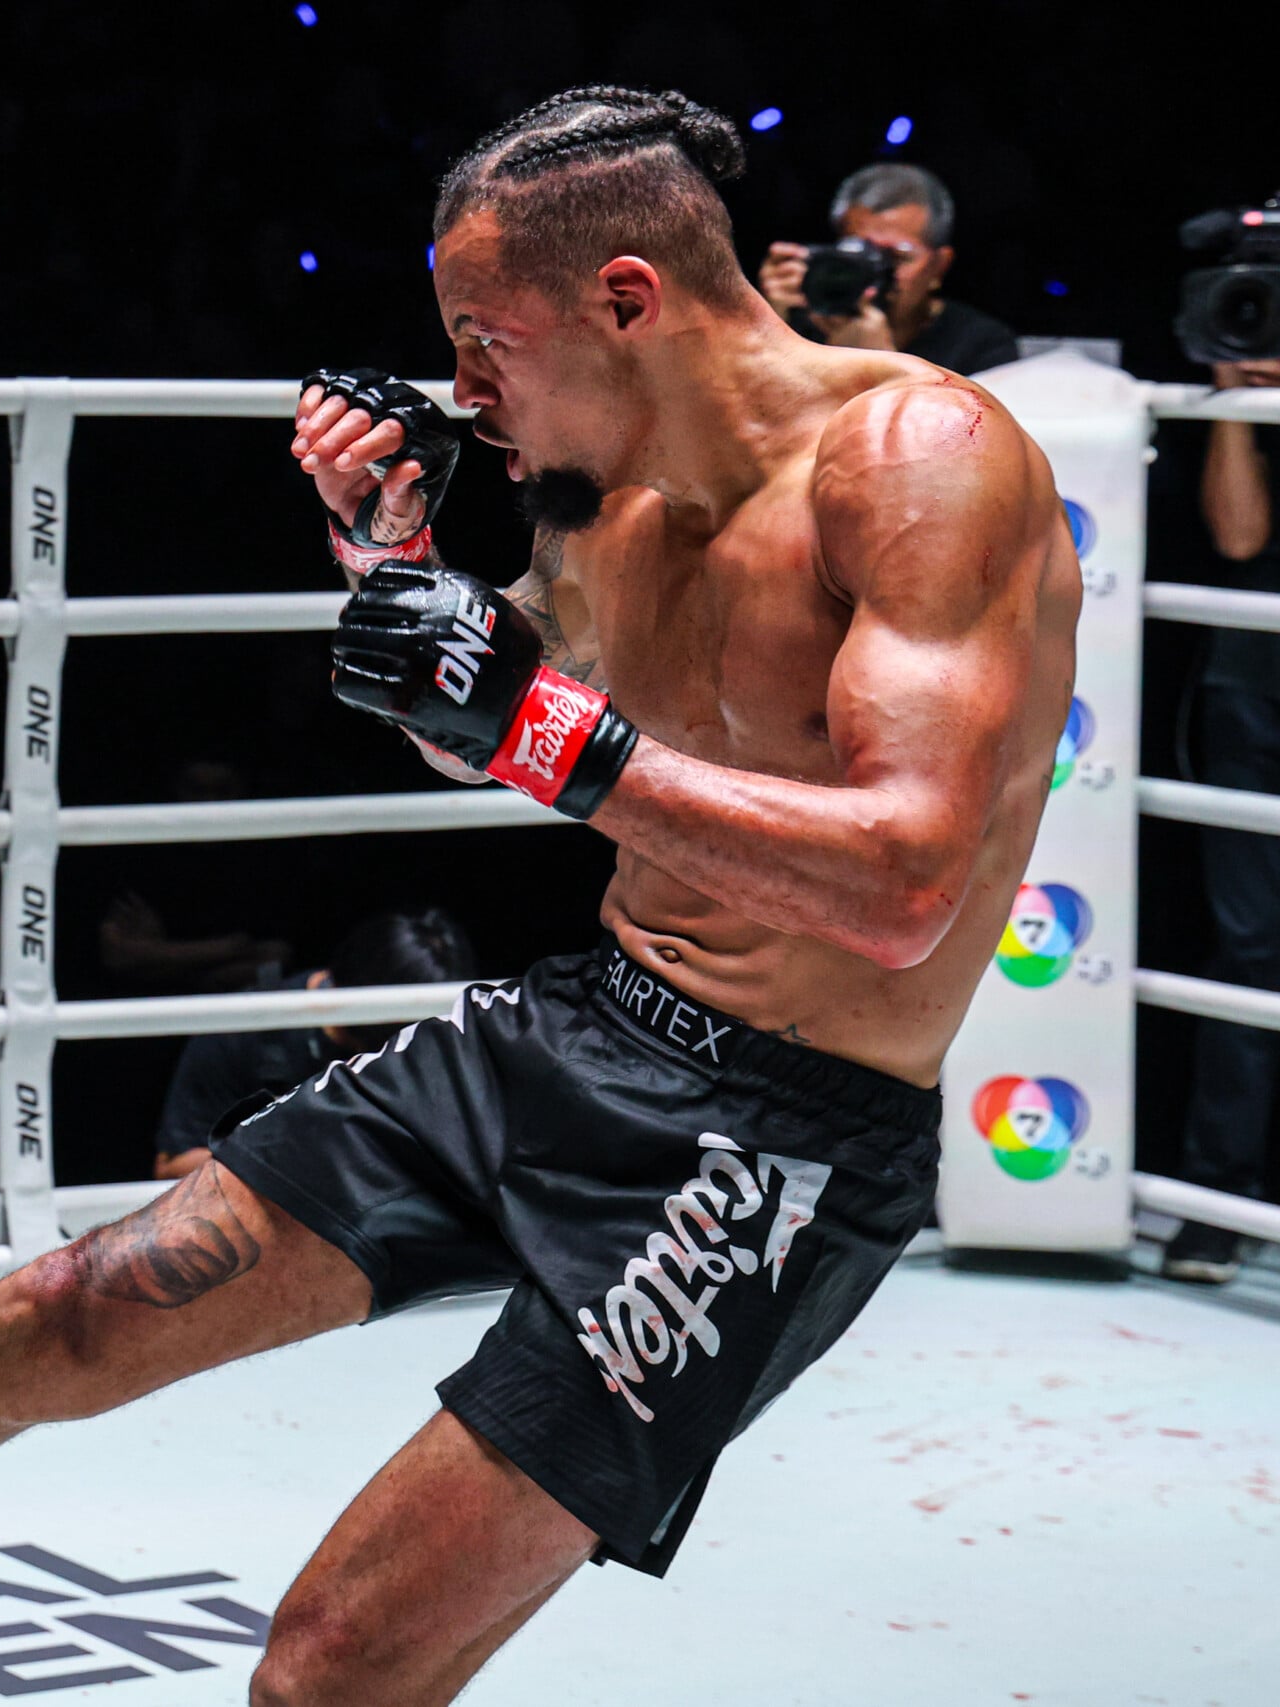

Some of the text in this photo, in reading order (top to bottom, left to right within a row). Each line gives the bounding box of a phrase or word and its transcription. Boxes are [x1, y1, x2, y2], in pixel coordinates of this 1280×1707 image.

[29, 485, 57, 566] ONE
[435, 588, 496, 705] ONE
[23, 684, 52, 765] ONE
[511, 682, 590, 780] Fairtex
[18, 884, 47, 963] ONE
[602, 949, 732, 1063] FAIRTEX
[14, 1082, 43, 1162] ONE
[577, 1131, 833, 1422] Fairtex
